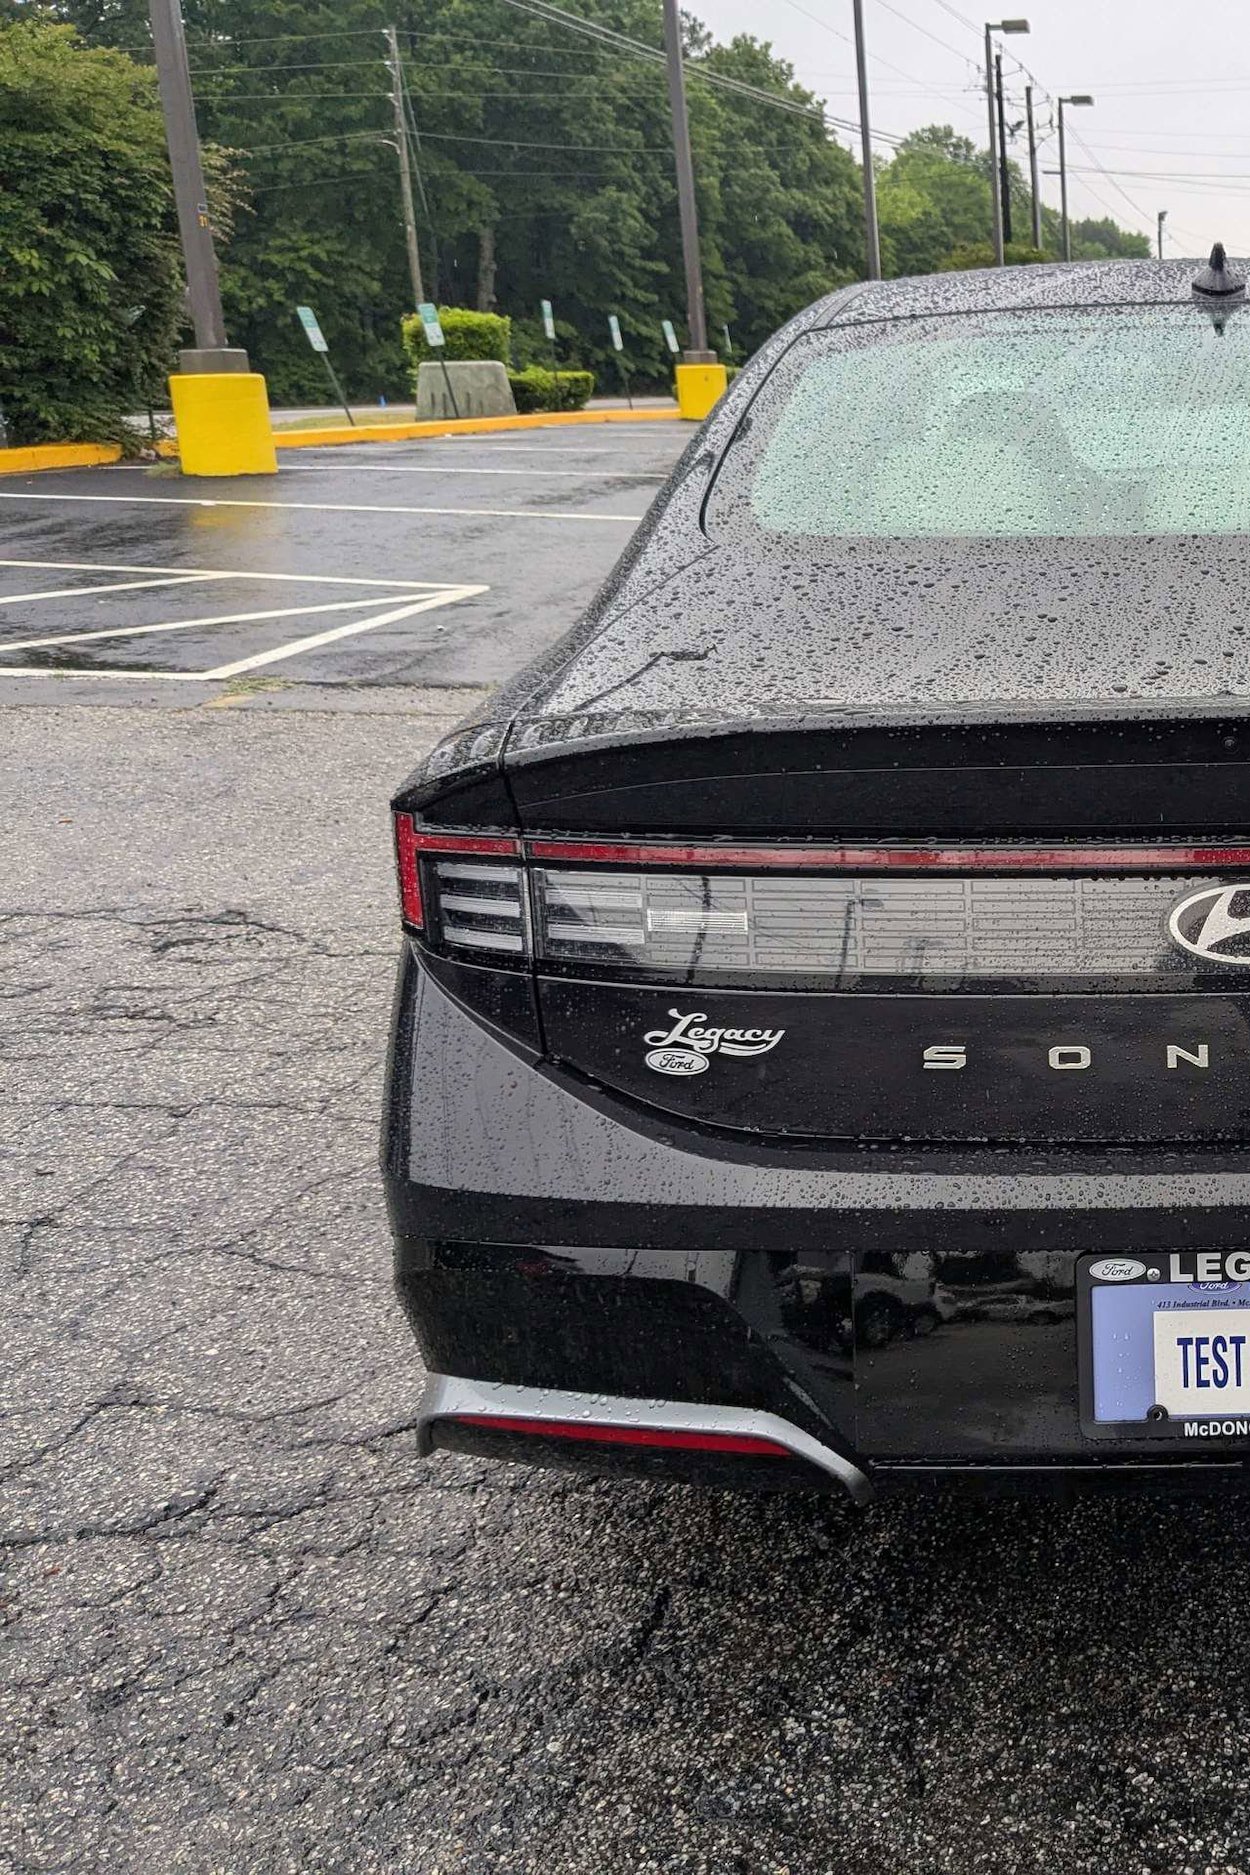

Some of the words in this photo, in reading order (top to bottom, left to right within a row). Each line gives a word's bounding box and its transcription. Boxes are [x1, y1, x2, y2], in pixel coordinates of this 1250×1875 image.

[643, 1008, 786, 1057] Legacy
[658, 1053, 694, 1071] Ford
[1173, 1300, 1210, 1309] Industrial
[1176, 1335, 1246, 1389] TEST
